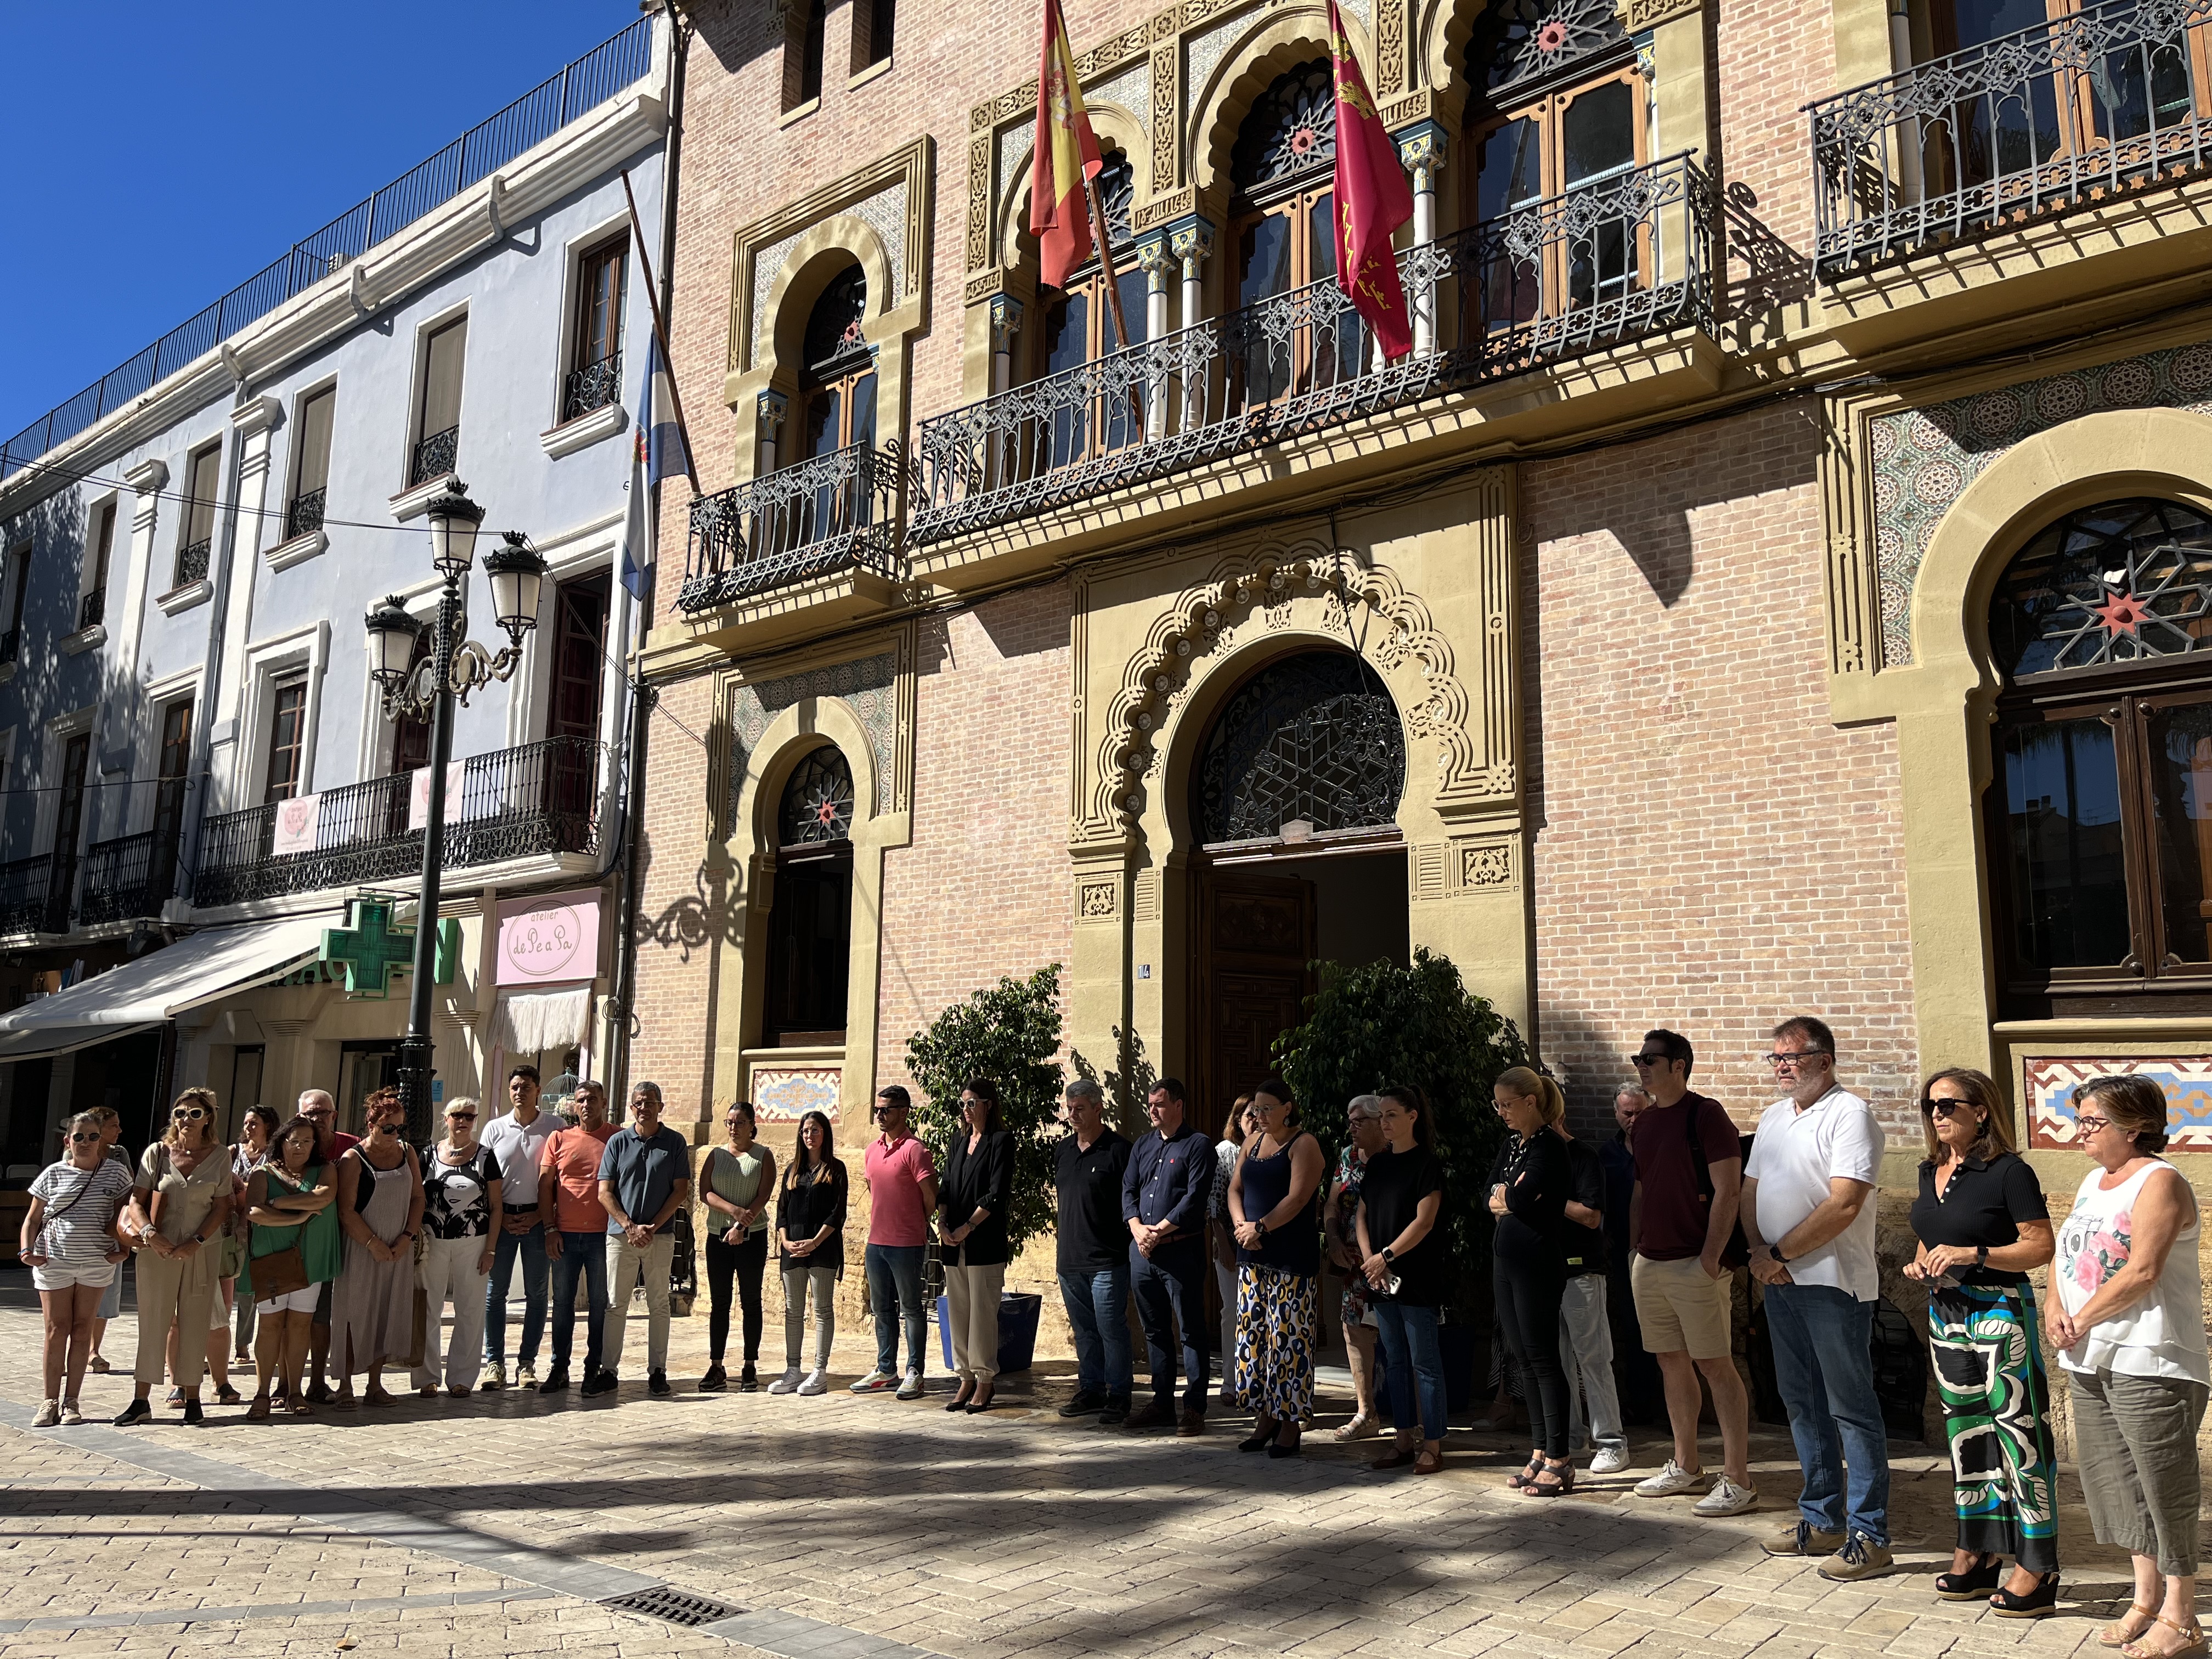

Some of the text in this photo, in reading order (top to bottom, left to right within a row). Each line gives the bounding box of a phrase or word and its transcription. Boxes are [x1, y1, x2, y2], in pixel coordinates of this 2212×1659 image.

[531, 910, 558, 922] atelier
[514, 935, 526, 955] de
[554, 924, 573, 951] Pa
[1138, 964, 1149, 978] 14
